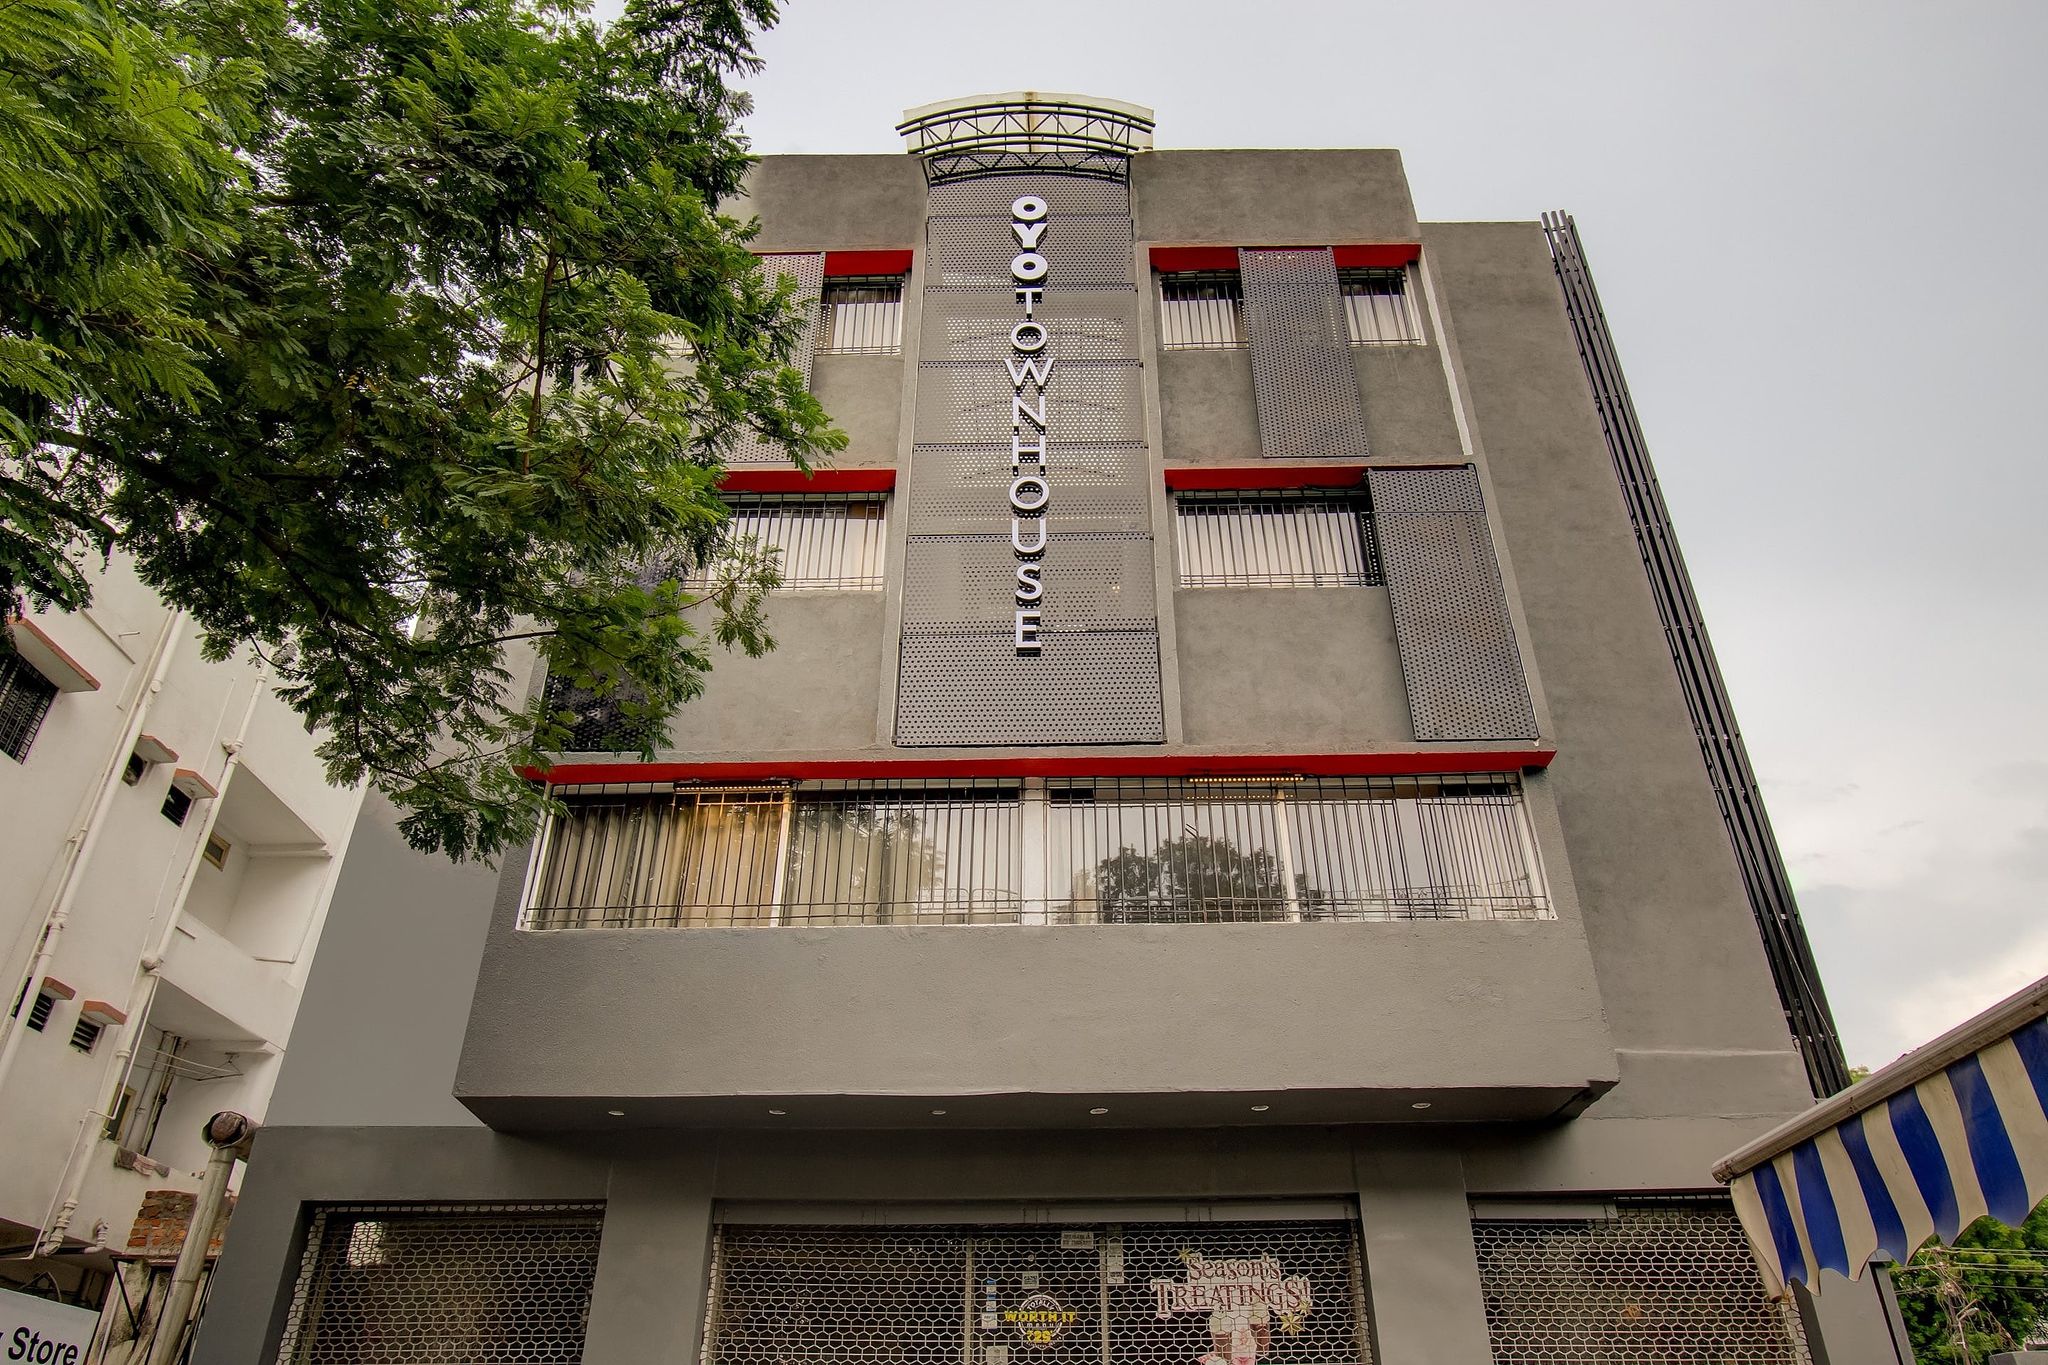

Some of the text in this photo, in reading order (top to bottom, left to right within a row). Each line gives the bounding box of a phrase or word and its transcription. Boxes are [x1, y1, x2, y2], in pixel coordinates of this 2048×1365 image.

[1004, 1311, 1058, 1322] WORTH
[1061, 1311, 1076, 1322] IT
[8, 1326, 79, 1365] Store
